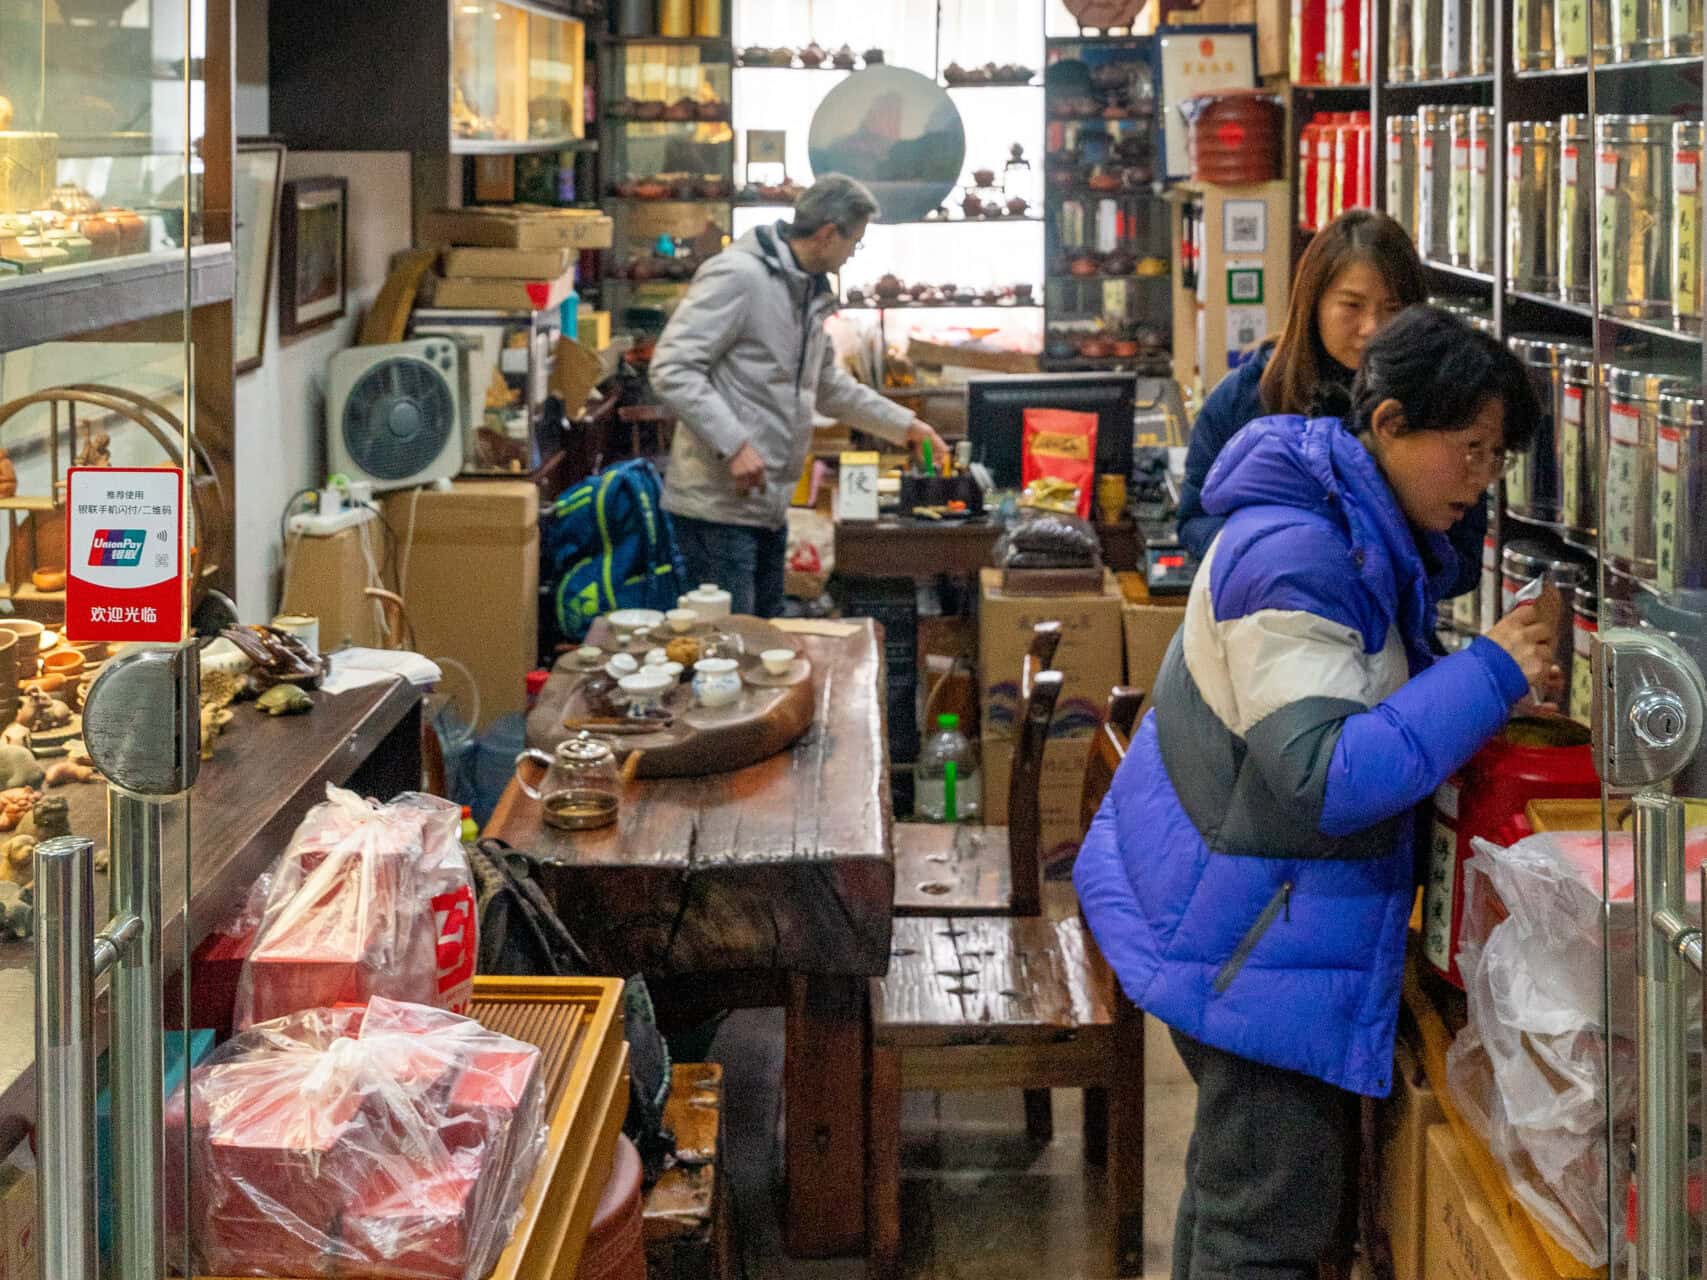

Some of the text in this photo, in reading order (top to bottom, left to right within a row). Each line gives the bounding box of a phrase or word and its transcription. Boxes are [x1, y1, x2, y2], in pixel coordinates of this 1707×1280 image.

[106, 491, 144, 500] 推荐使用
[94, 538, 142, 553] UnionPay
[91, 606, 157, 623] 欢迎光临
